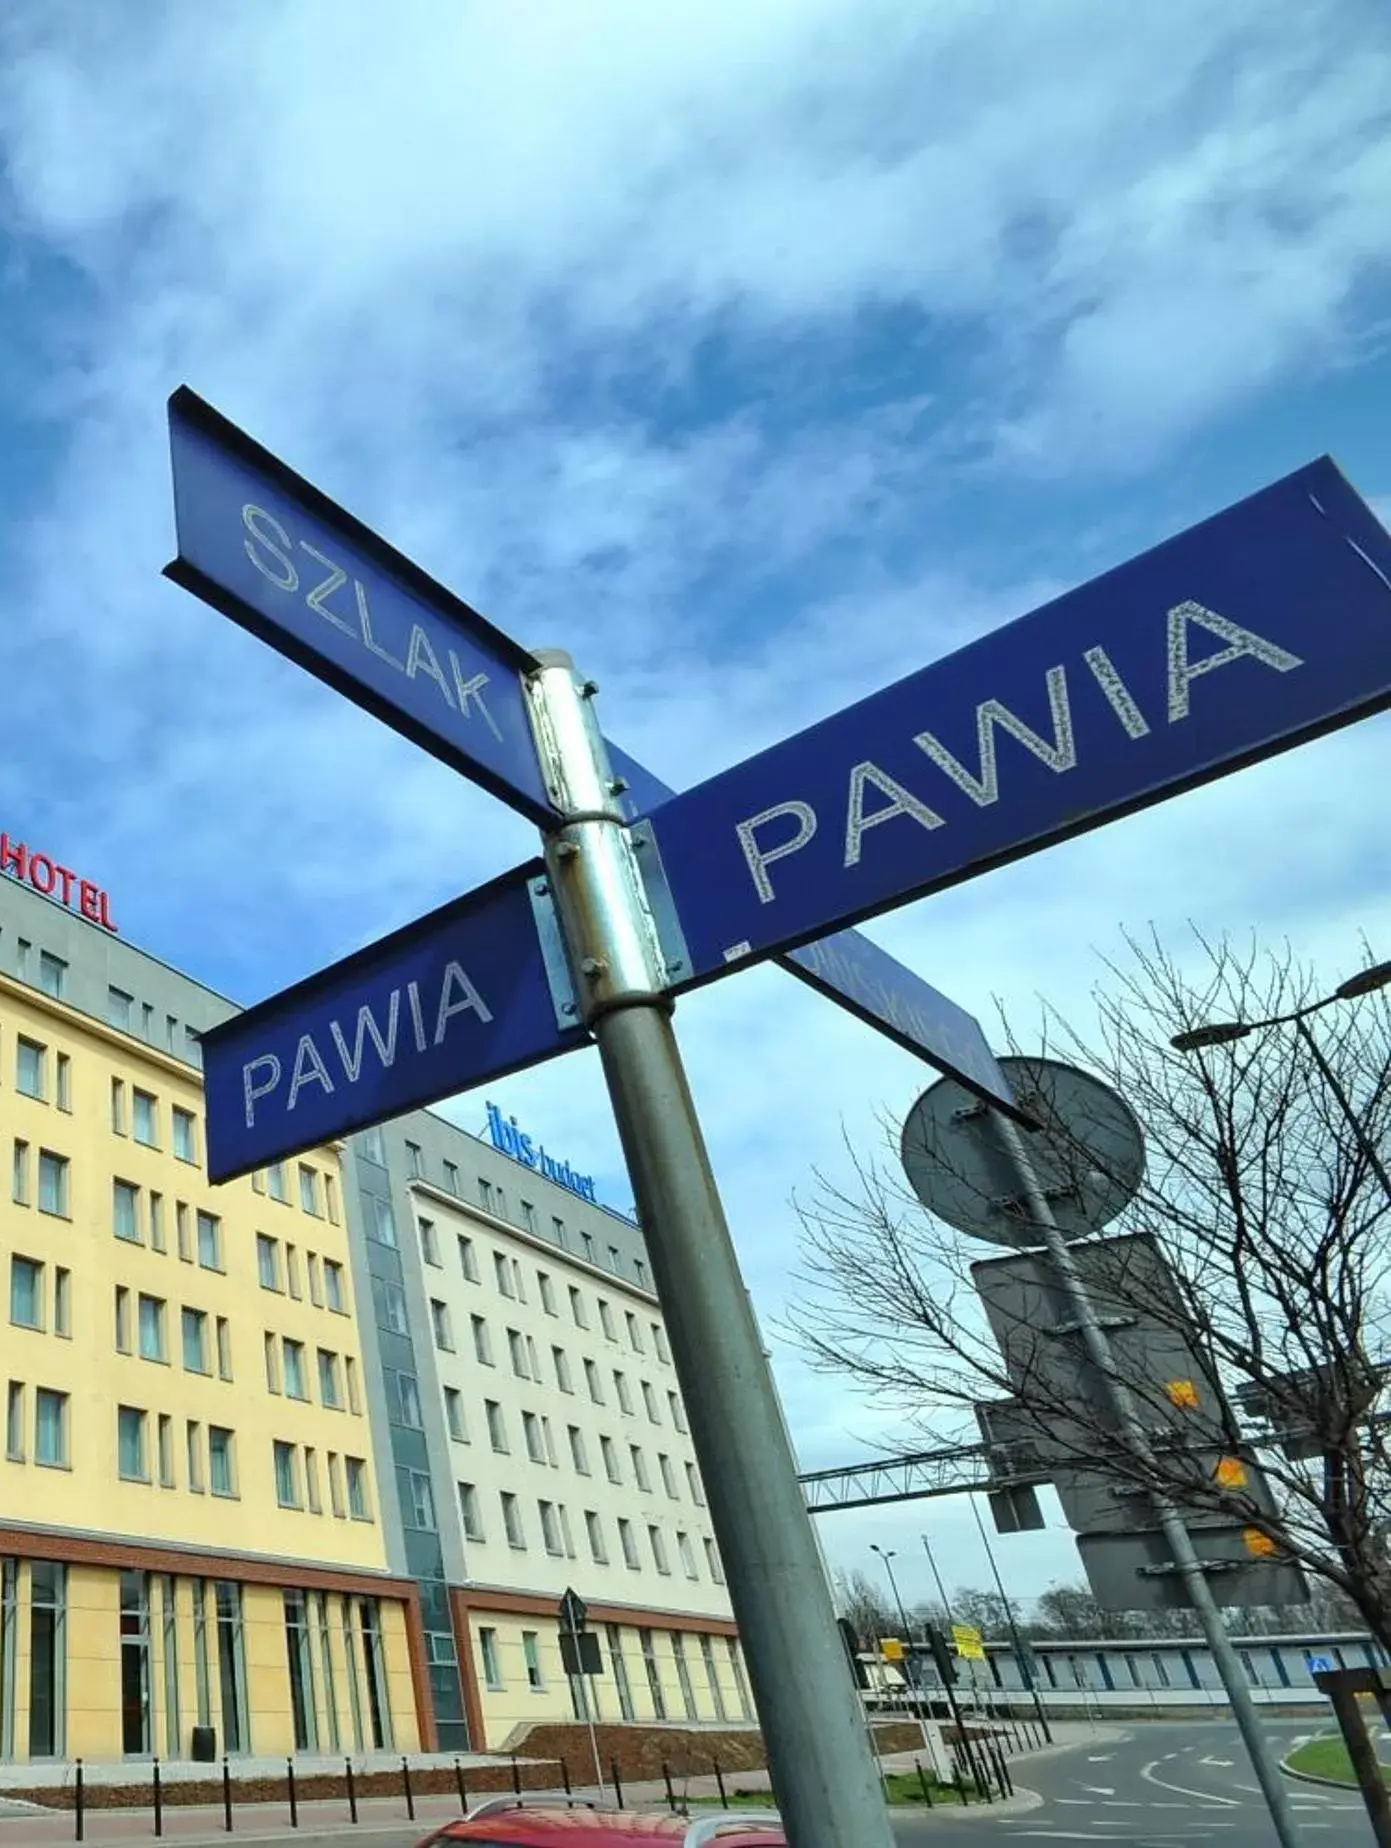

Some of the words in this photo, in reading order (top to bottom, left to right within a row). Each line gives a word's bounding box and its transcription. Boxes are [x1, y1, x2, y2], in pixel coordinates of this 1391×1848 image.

[242, 503, 504, 743] SZLAK
[735, 599, 1305, 905] PAWIA
[0, 831, 118, 933] HOTEL
[242, 960, 494, 1129] PAWIA
[485, 1099, 537, 1169] ibis
